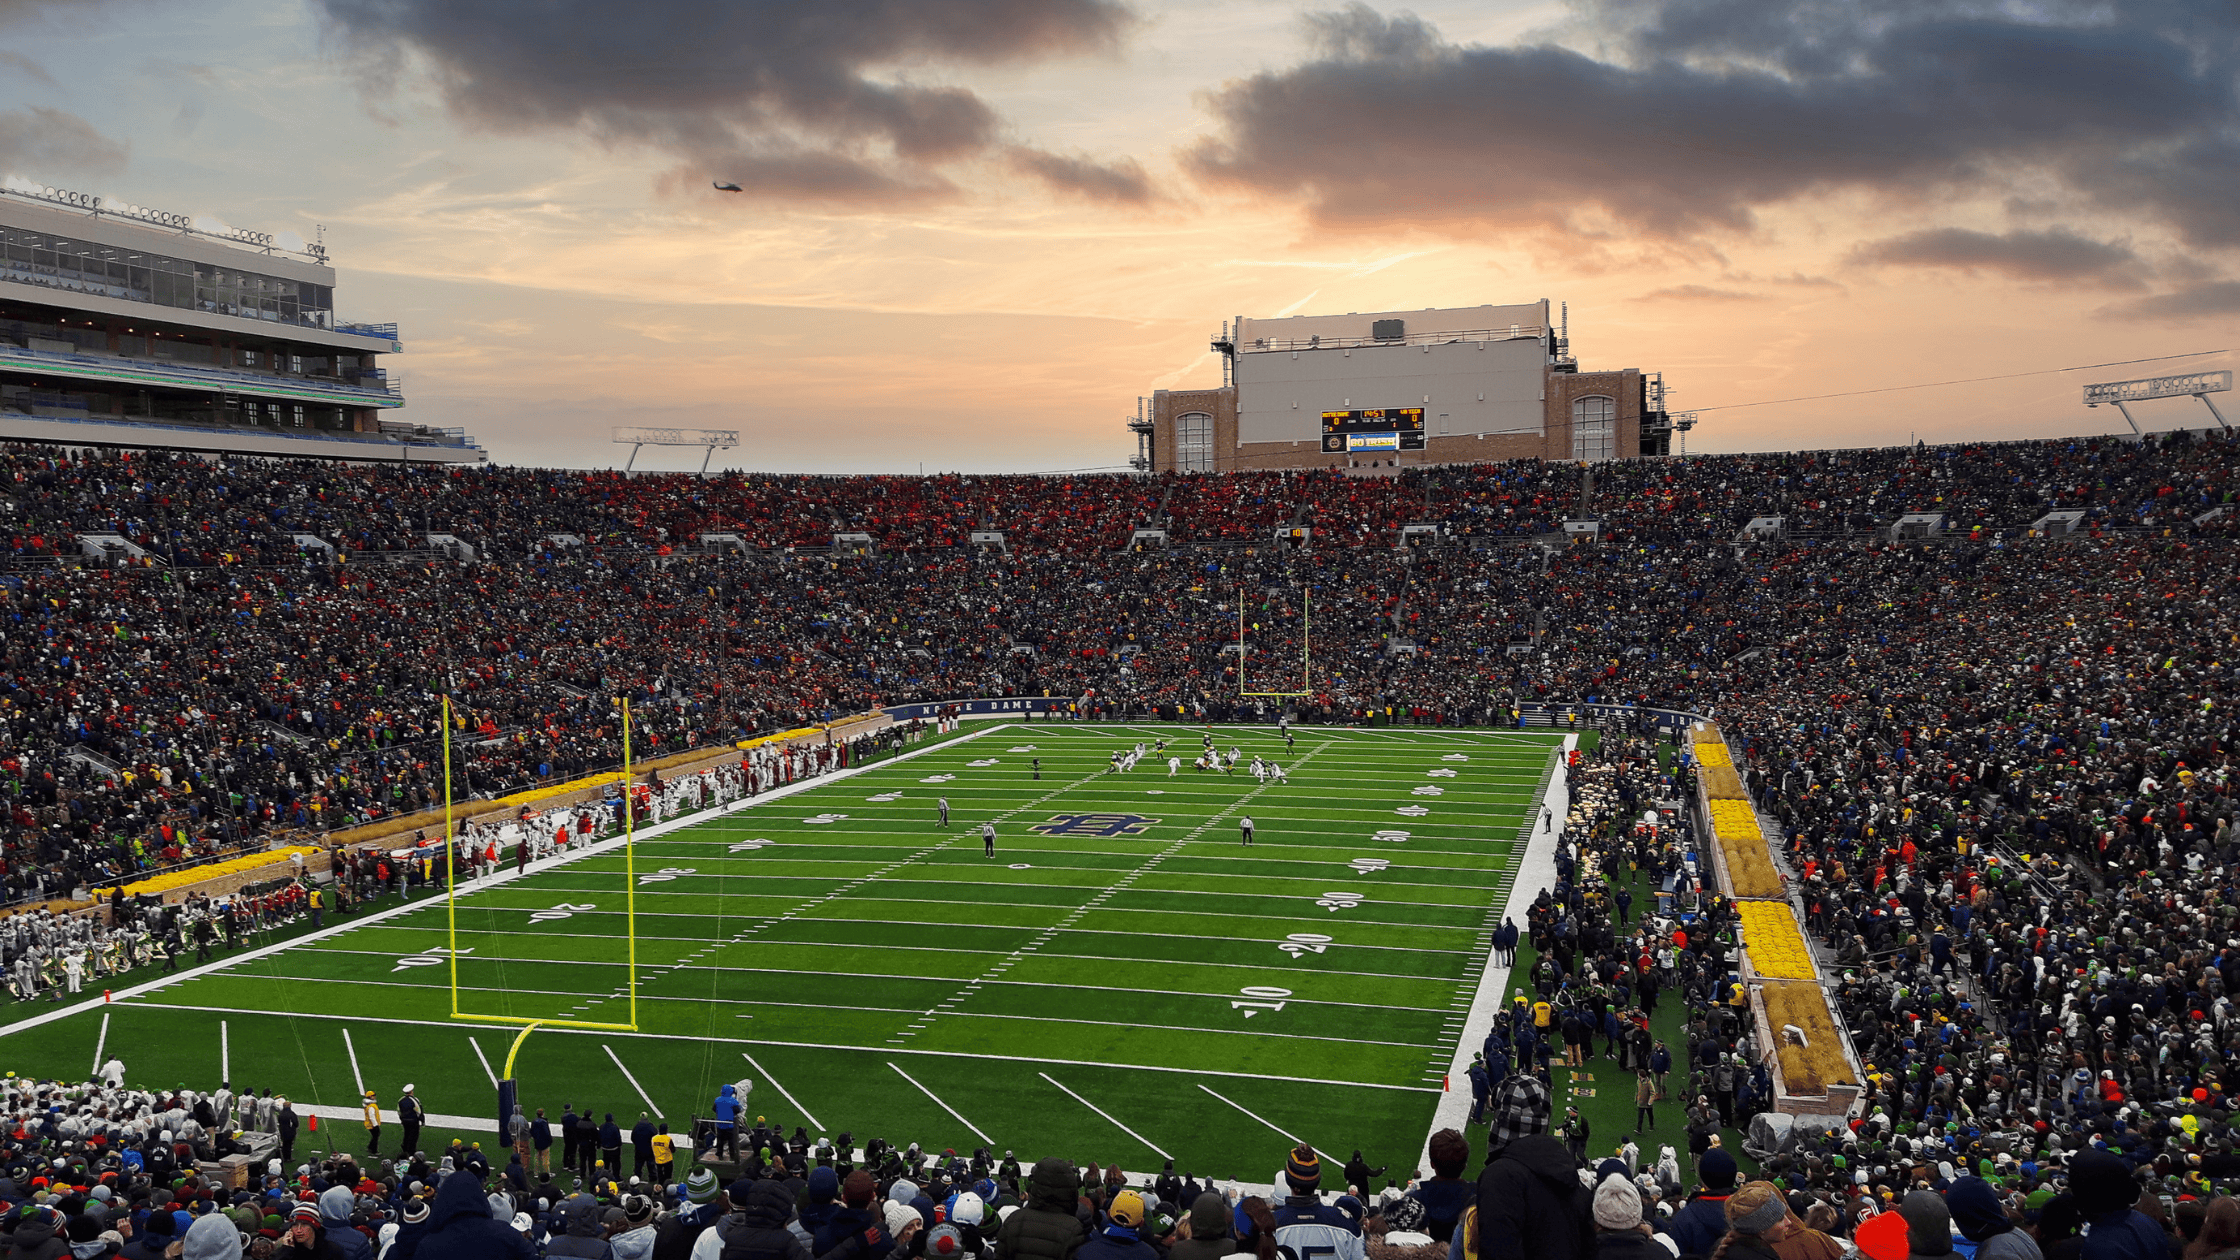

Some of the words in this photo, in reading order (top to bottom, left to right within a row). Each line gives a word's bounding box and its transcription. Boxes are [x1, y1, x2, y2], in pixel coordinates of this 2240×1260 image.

[1364, 410, 1385, 418] 14:57
[992, 701, 1032, 710] DAME
[1316, 892, 1364, 908] 30
[530, 903, 596, 918] 20
[1278, 934, 1332, 954] 20
[1231, 986, 1292, 1012] 10
